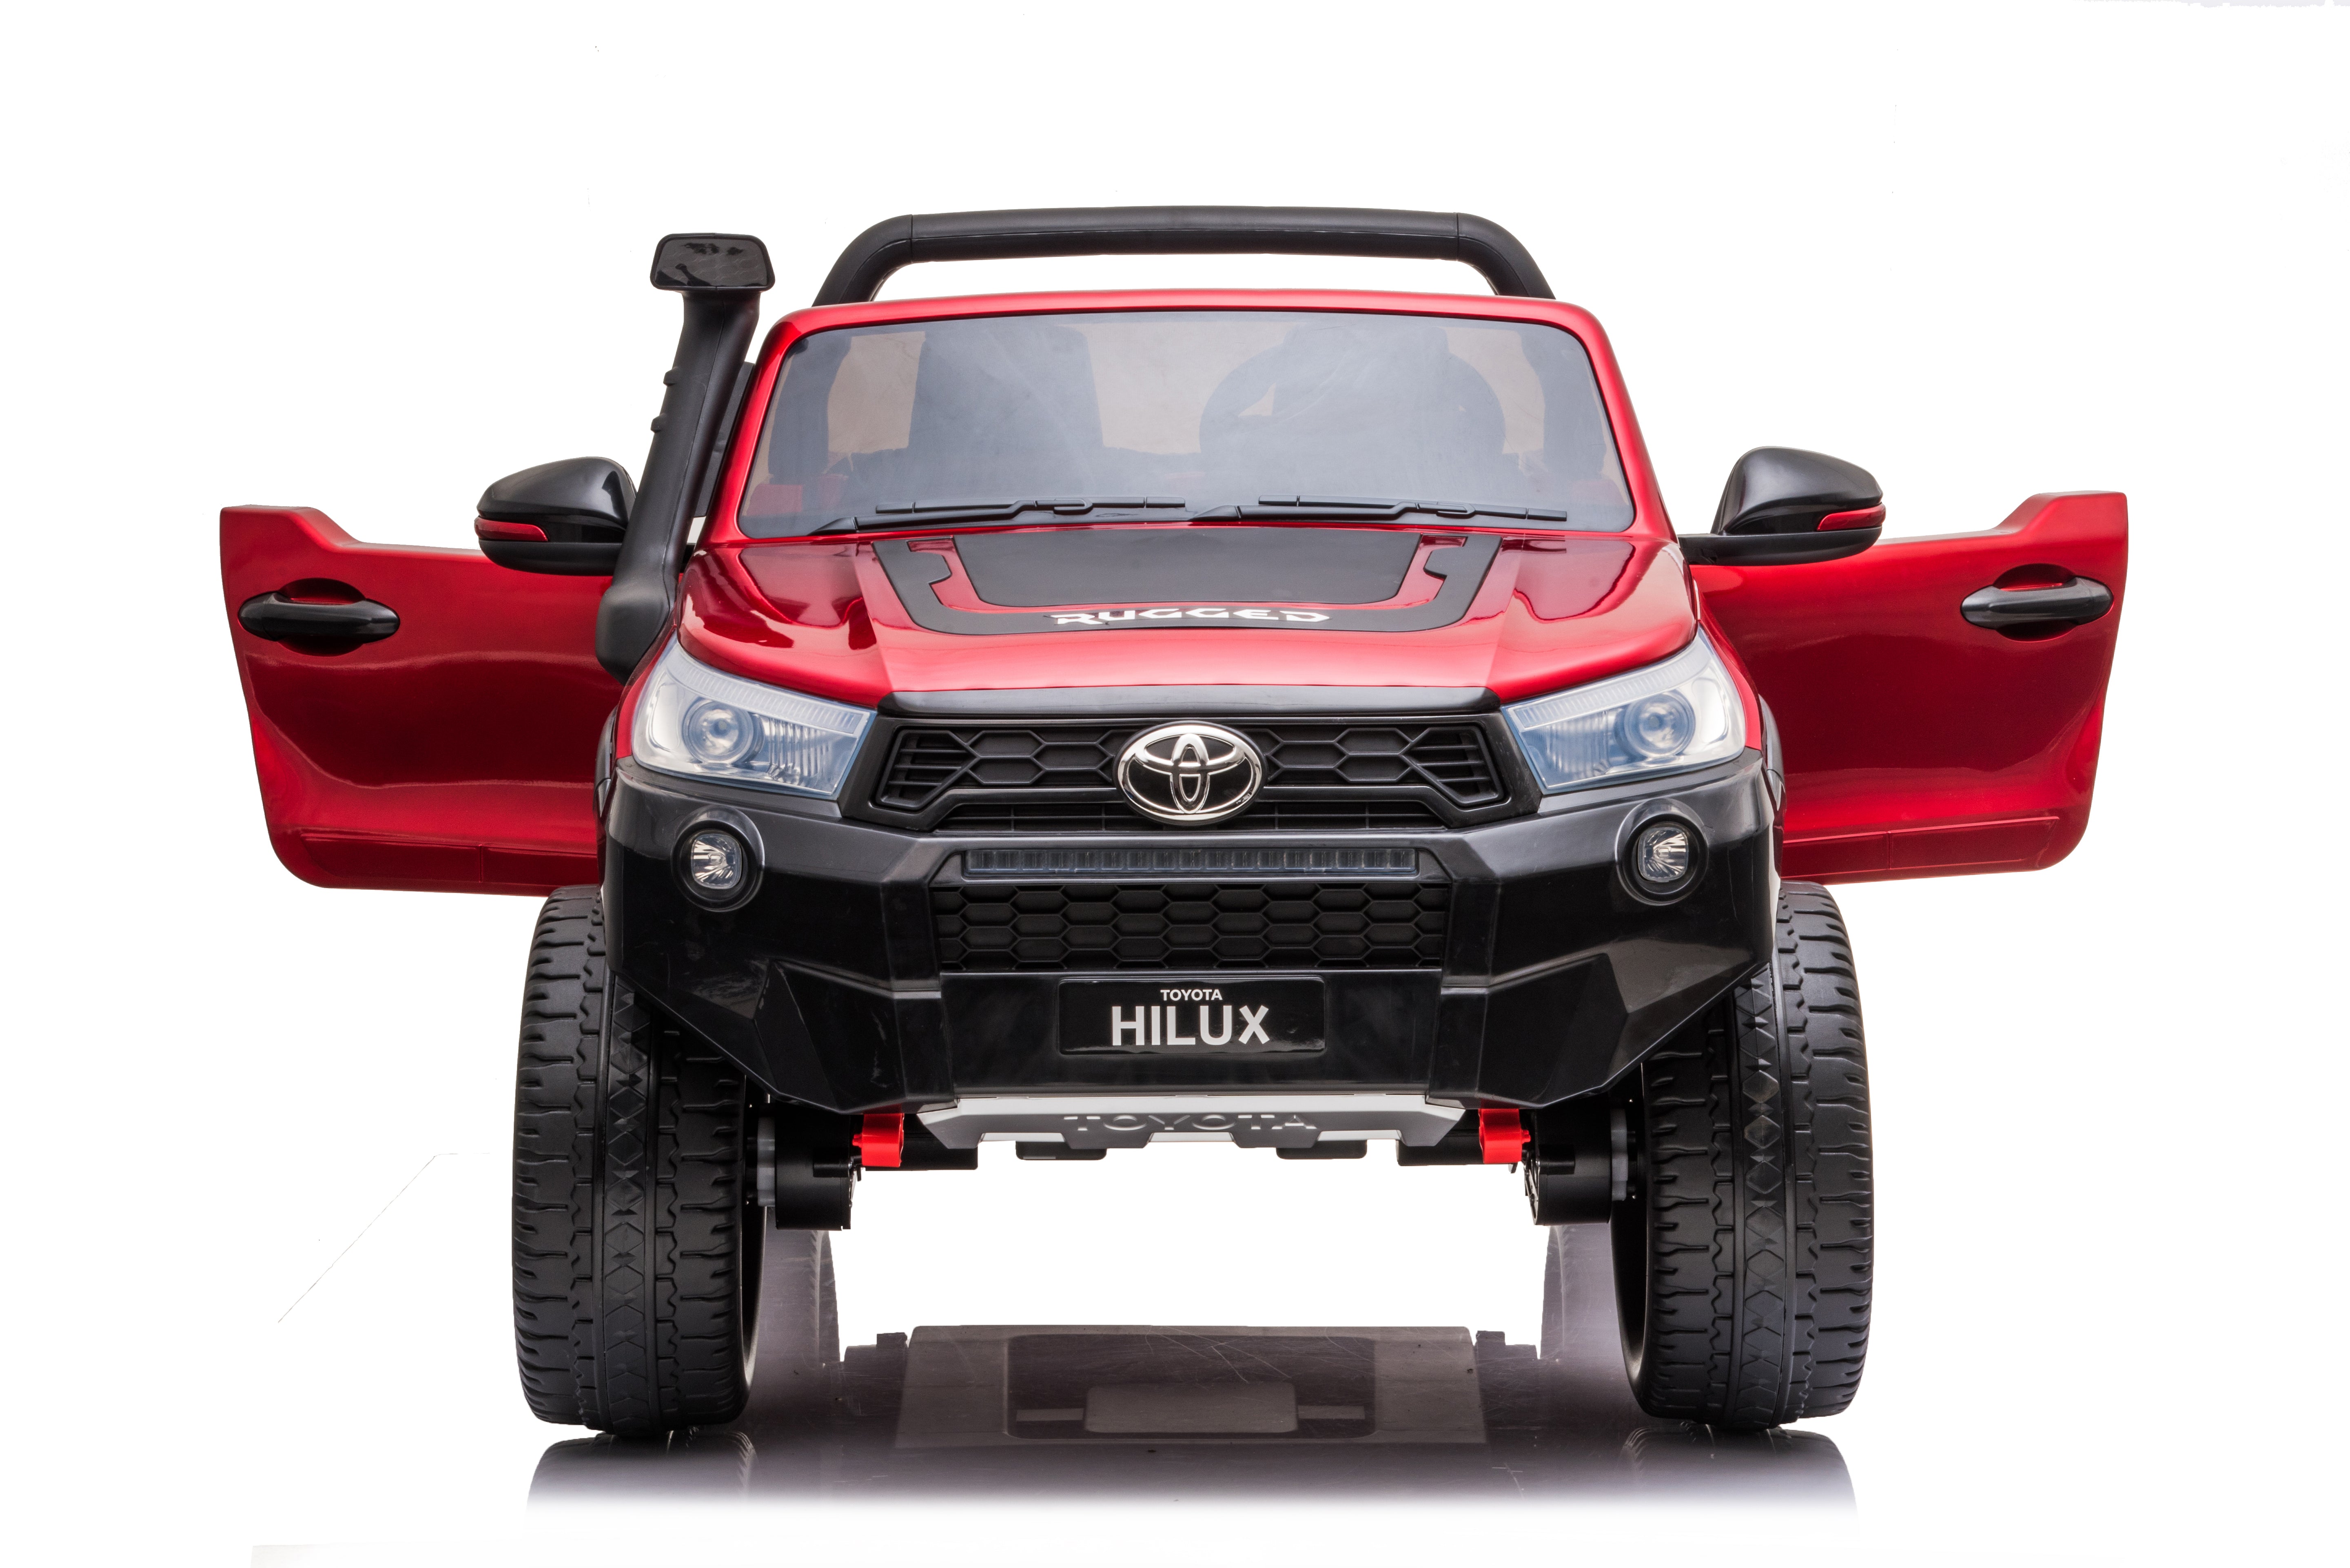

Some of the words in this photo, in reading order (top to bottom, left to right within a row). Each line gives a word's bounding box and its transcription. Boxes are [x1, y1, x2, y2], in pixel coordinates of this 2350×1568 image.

[1050, 607, 1330, 625] RUGGED
[1160, 989, 1223, 1001] TOYOTA
[1111, 1005, 1270, 1046] HILUX
[1063, 1114, 1317, 1131] TOYOTA
